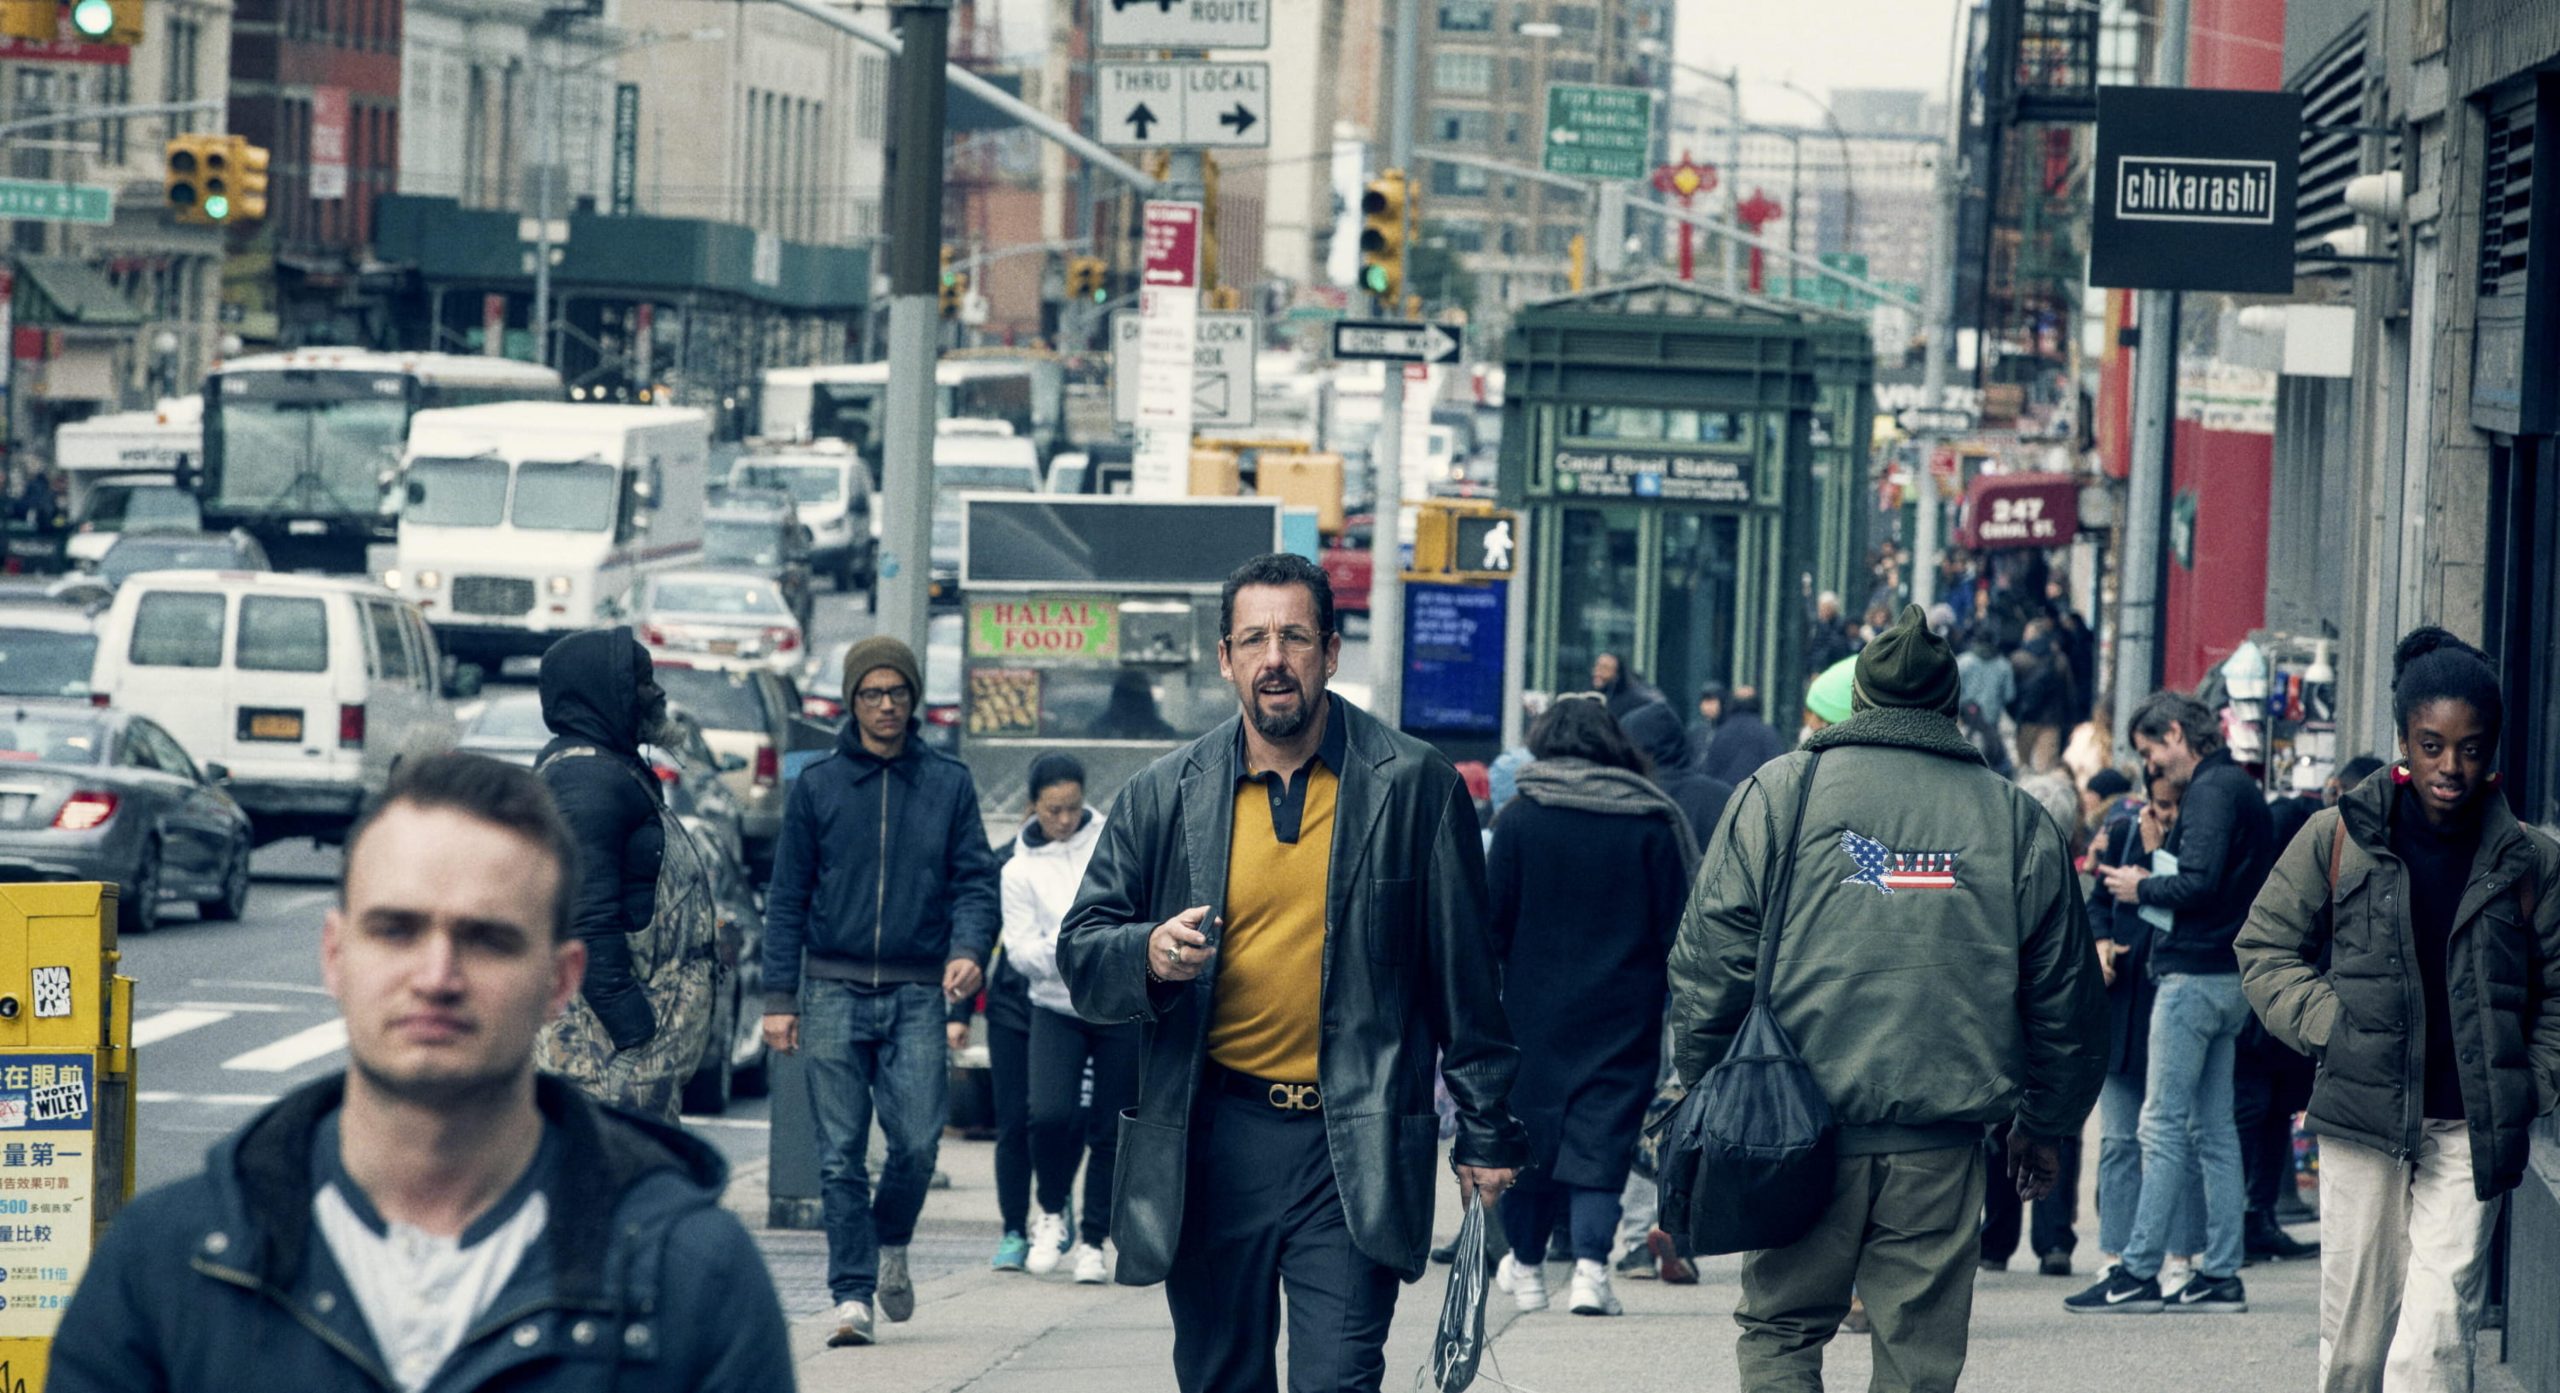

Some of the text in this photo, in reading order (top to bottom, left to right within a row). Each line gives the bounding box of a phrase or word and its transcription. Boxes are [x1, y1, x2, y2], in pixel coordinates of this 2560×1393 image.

[1191, 2, 1260, 22] ROUTE
[1115, 70, 1259, 92] THRU LOCAL
[2126, 167, 2267, 213] chikarashi
[1196, 322, 1244, 342] LOCK
[1556, 452, 1607, 471] Canal
[1672, 457, 1739, 478] Station
[994, 602, 1097, 627] HALAL
[1004, 627, 1085, 651] FOOD
[32, 967, 70, 985] DIVA
[34, 983, 70, 1001] DOG
[0, 1064, 83, 1090] 在眼前
[43, 1085, 74, 1097] VOTE
[37, 1093, 82, 1117] WILEY
[0, 1176, 70, 1190] 告效果可靠
